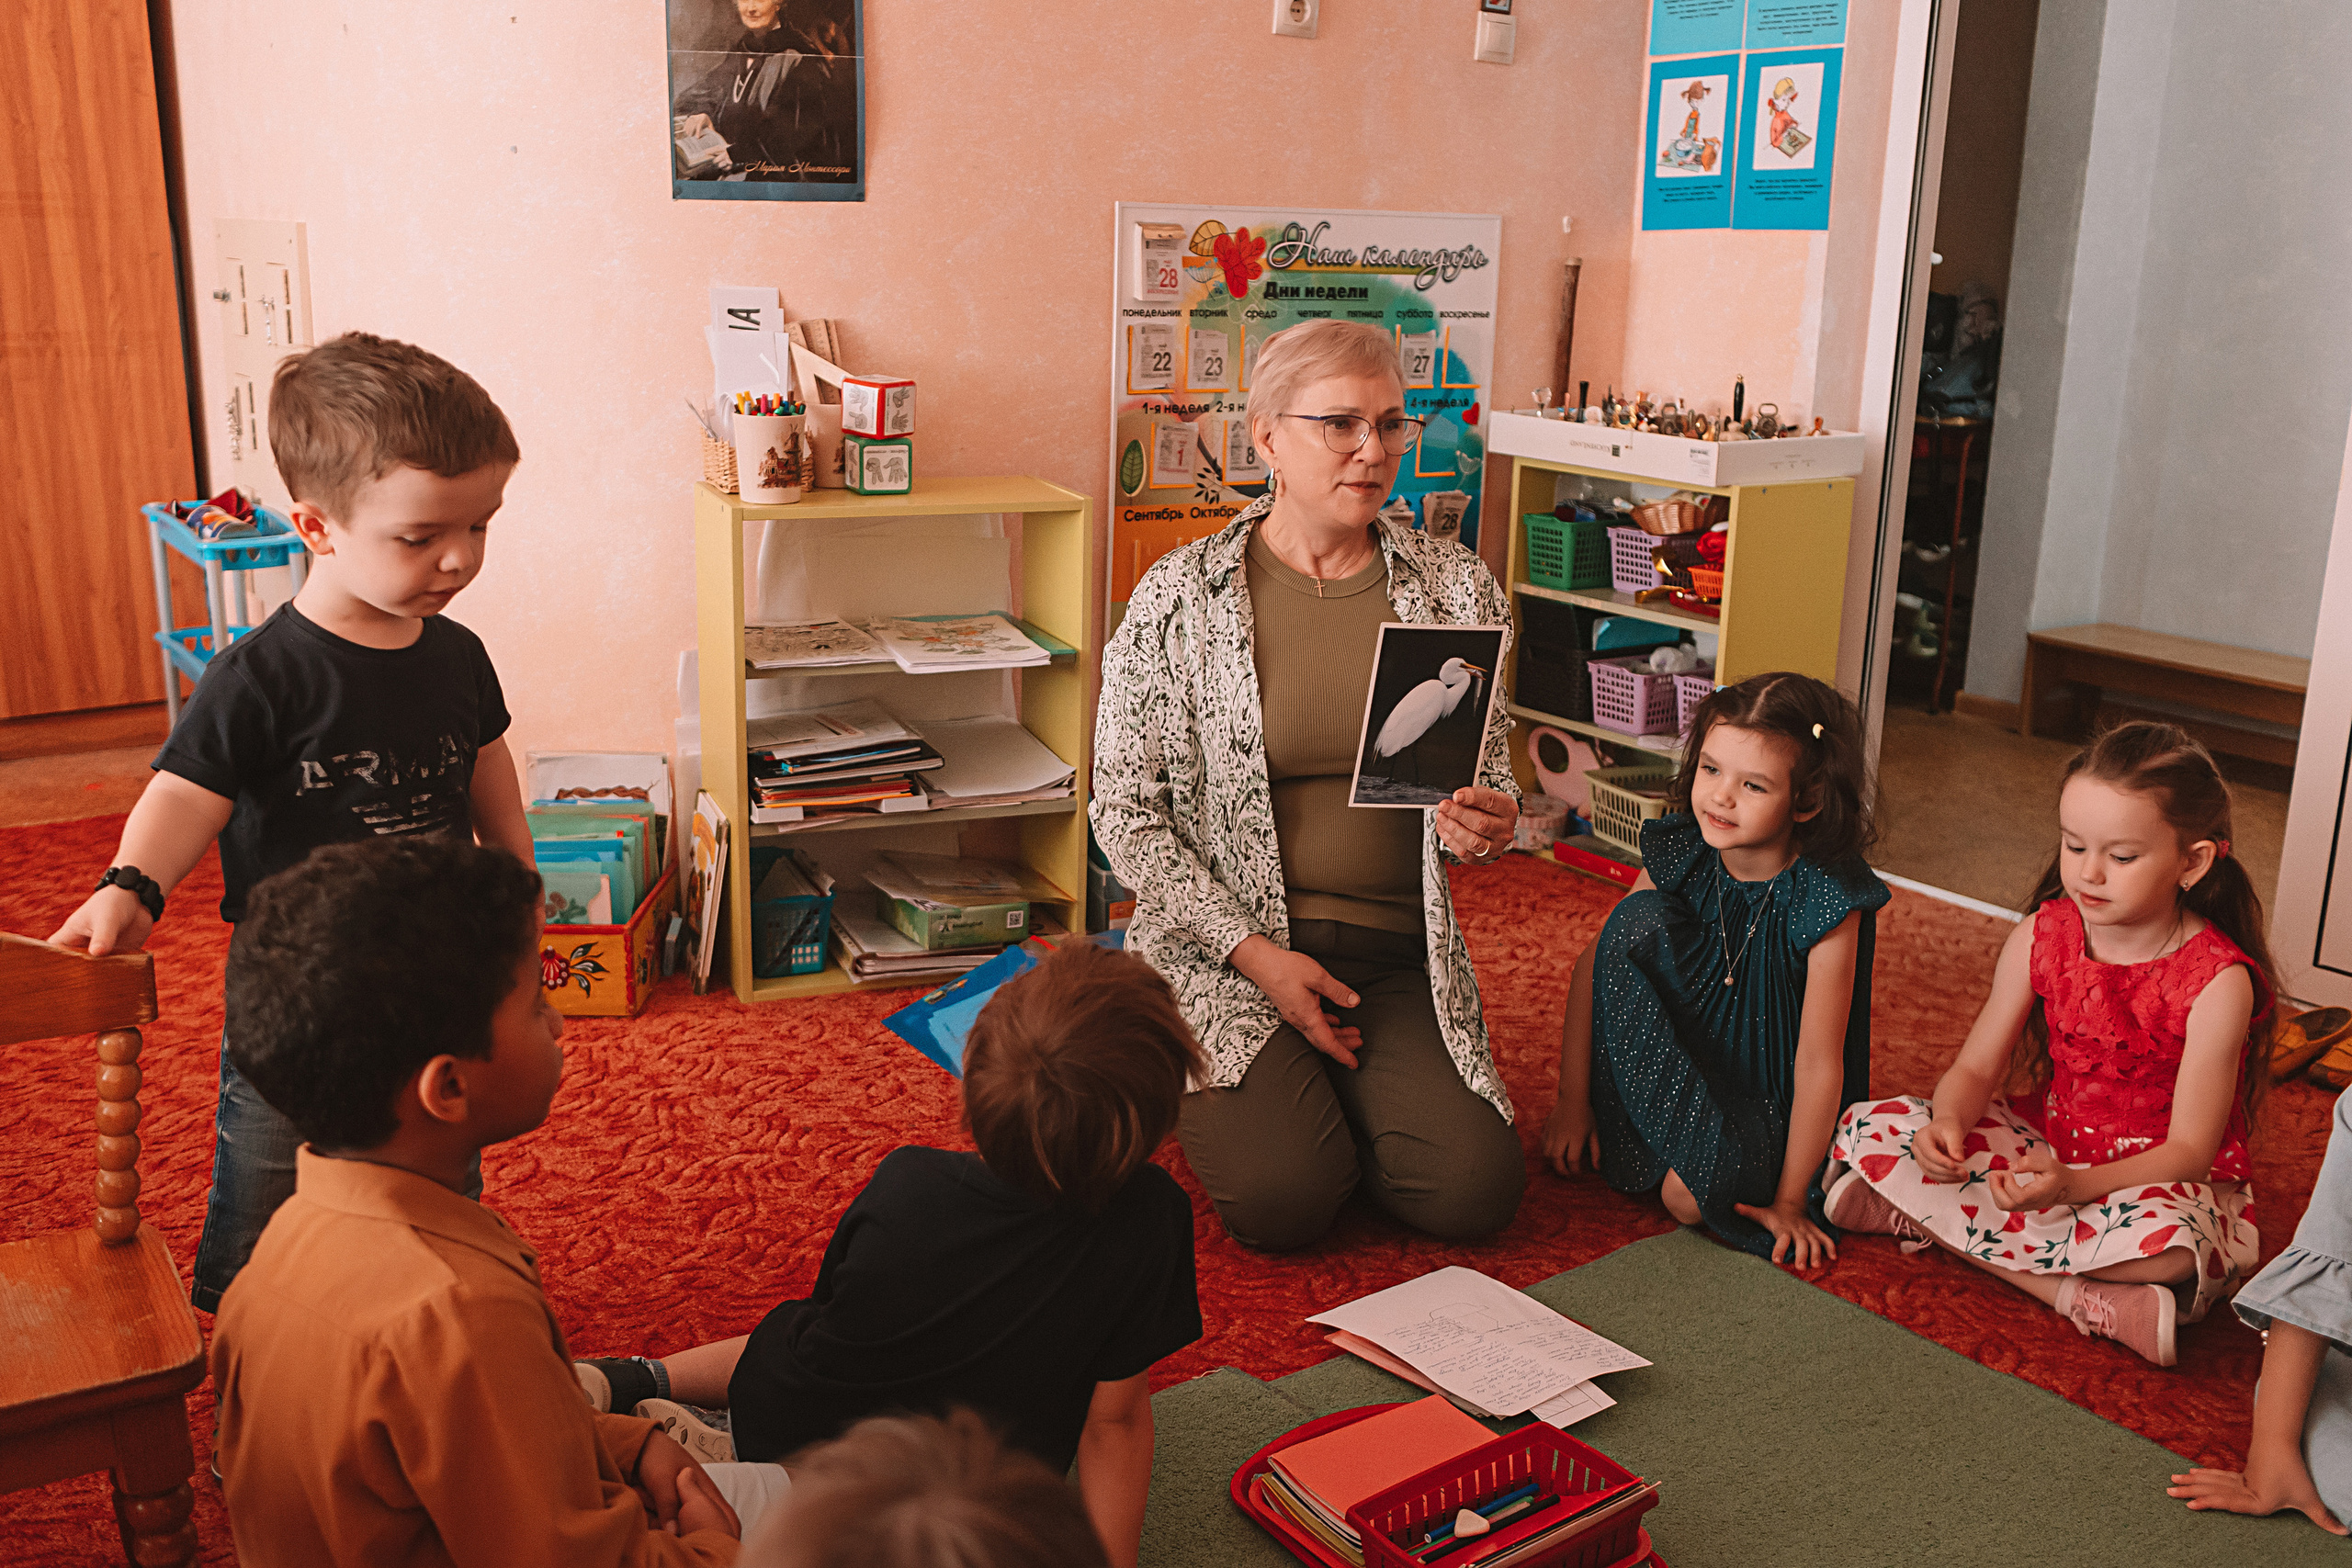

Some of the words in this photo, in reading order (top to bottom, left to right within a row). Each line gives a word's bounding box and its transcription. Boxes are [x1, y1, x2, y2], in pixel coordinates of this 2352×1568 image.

[744, 160, 786, 175] Мария
[788, 161, 852, 177] Монтессори
[1266, 221, 1358, 270] Наш
[1361, 243, 1489, 291] календарь
[1159, 267, 1179, 288] 28
[1263, 281, 1300, 299] Дни
[1305, 285, 1369, 299] недели
[1123, 309, 1183, 318] понедельник
[1190, 309, 1229, 319] вторник
[1245, 310, 1278, 319] среда
[1296, 310, 1333, 319] четверг
[1347, 310, 1384, 320] пятница
[1396, 309, 1434, 320] суббота
[1440, 310, 1490, 320] воскресенье
[1153, 351, 1171, 372] 22
[1204, 356, 1224, 377] 23
[1413, 355, 1430, 374] 27
[1142, 402, 1161, 414] 1-я
[1164, 402, 1210, 415] неделя
[1216, 400, 1235, 412] 2-я
[1410, 397, 1428, 408] 4-я
[1429, 397, 1469, 409] неделя
[1177, 447, 1184, 467] 1
[1246, 446, 1256, 465] 8
[1124, 508, 1184, 522] Сентябрь
[1190, 505, 1242, 520] Октябрь
[1441, 513, 1459, 531] 28
